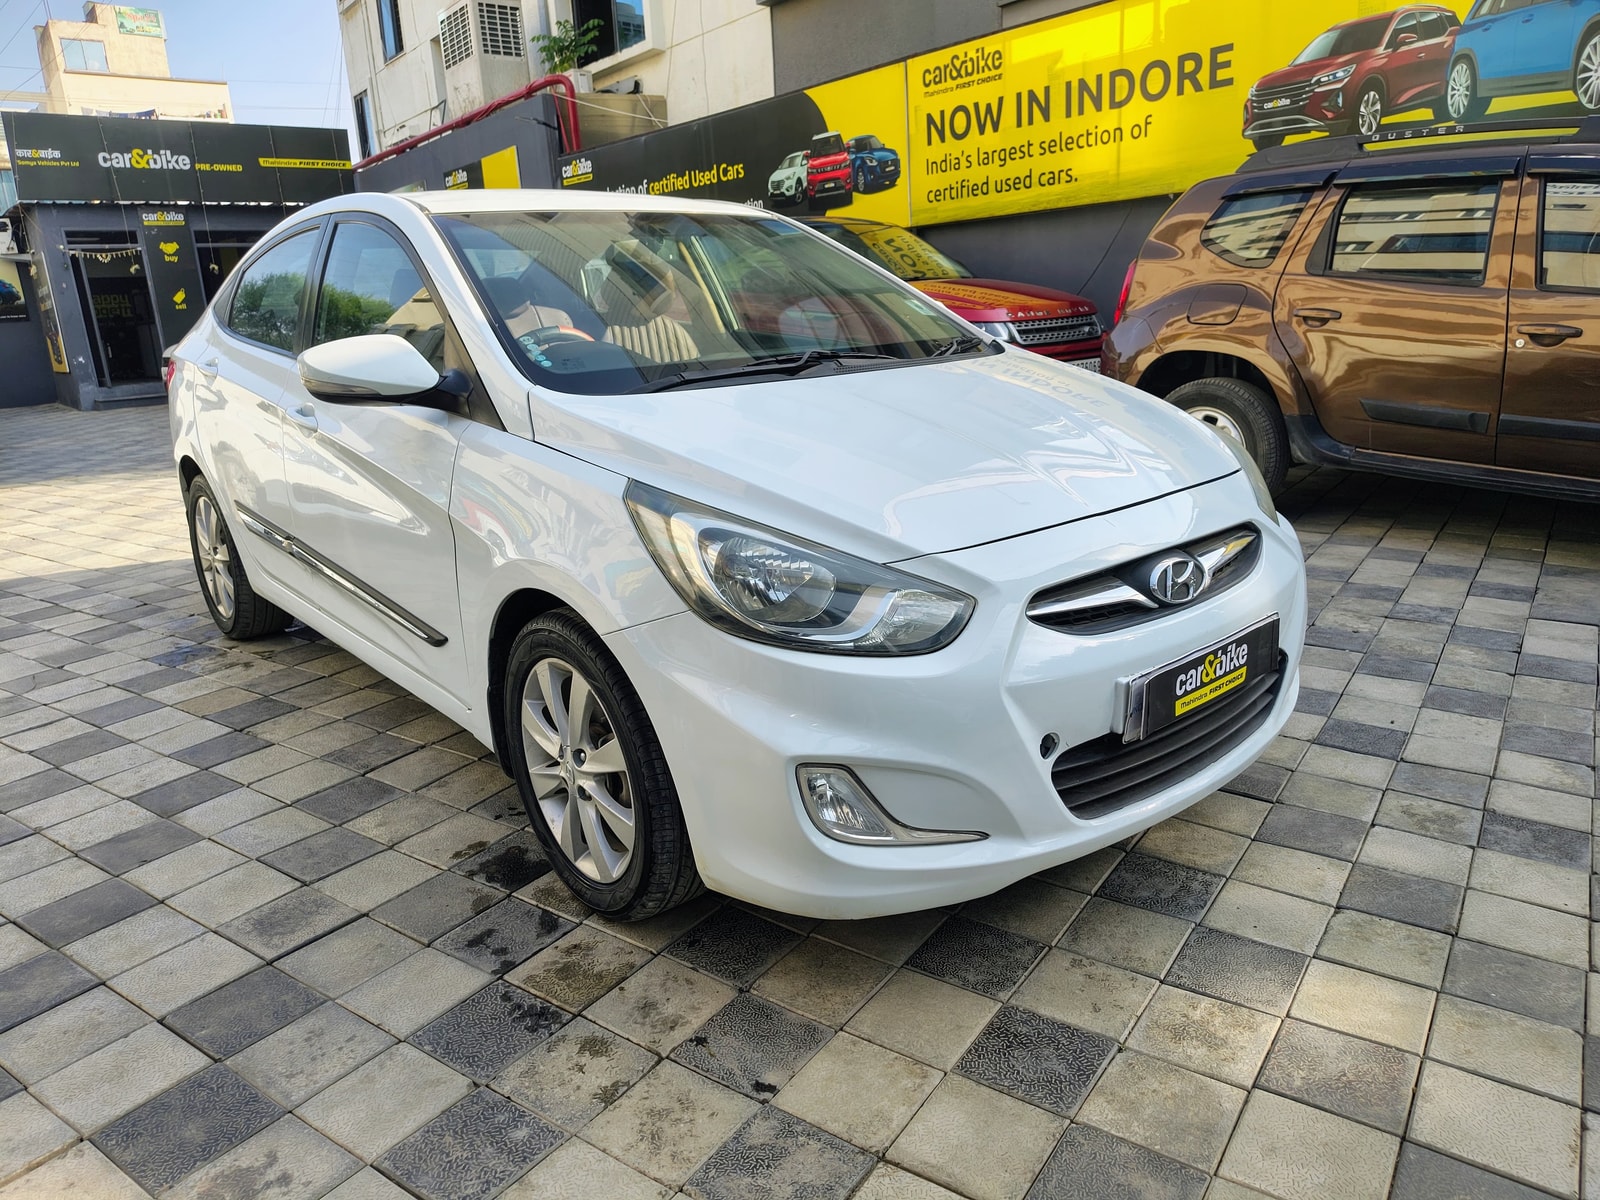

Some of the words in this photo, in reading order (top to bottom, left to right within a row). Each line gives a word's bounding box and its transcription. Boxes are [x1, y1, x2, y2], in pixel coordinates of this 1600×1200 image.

[922, 47, 1003, 88] car&bike
[955, 80, 976, 91] FIRST
[976, 73, 1003, 85] CHOICE
[926, 96, 1004, 146] NOW
[1016, 85, 1050, 129] IN
[1065, 42, 1235, 119] INDORE
[926, 150, 973, 176] India's
[977, 142, 1034, 168] largest
[1039, 121, 1124, 157] selection
[1131, 114, 1152, 140] of
[1372, 126, 1464, 141] DUSTER
[98, 149, 191, 170] car&bike
[195, 163, 243, 172] PRE-OWNED
[562, 158, 593, 178] car&bike
[649, 170, 690, 195] certified
[691, 164, 718, 188] Used
[719, 163, 745, 182] Cars
[927, 176, 990, 203] certified
[994, 168, 1033, 193] used
[1038, 167, 1078, 187] cars.
[142, 211, 185, 221] car&bike
[164, 254, 179, 263] buy
[1175, 642, 1248, 696] car&bike
[1180, 692, 1208, 709] Mahindra
[1209, 683, 1225, 695] FIRST
[1225, 672, 1243, 687] CHOICE
